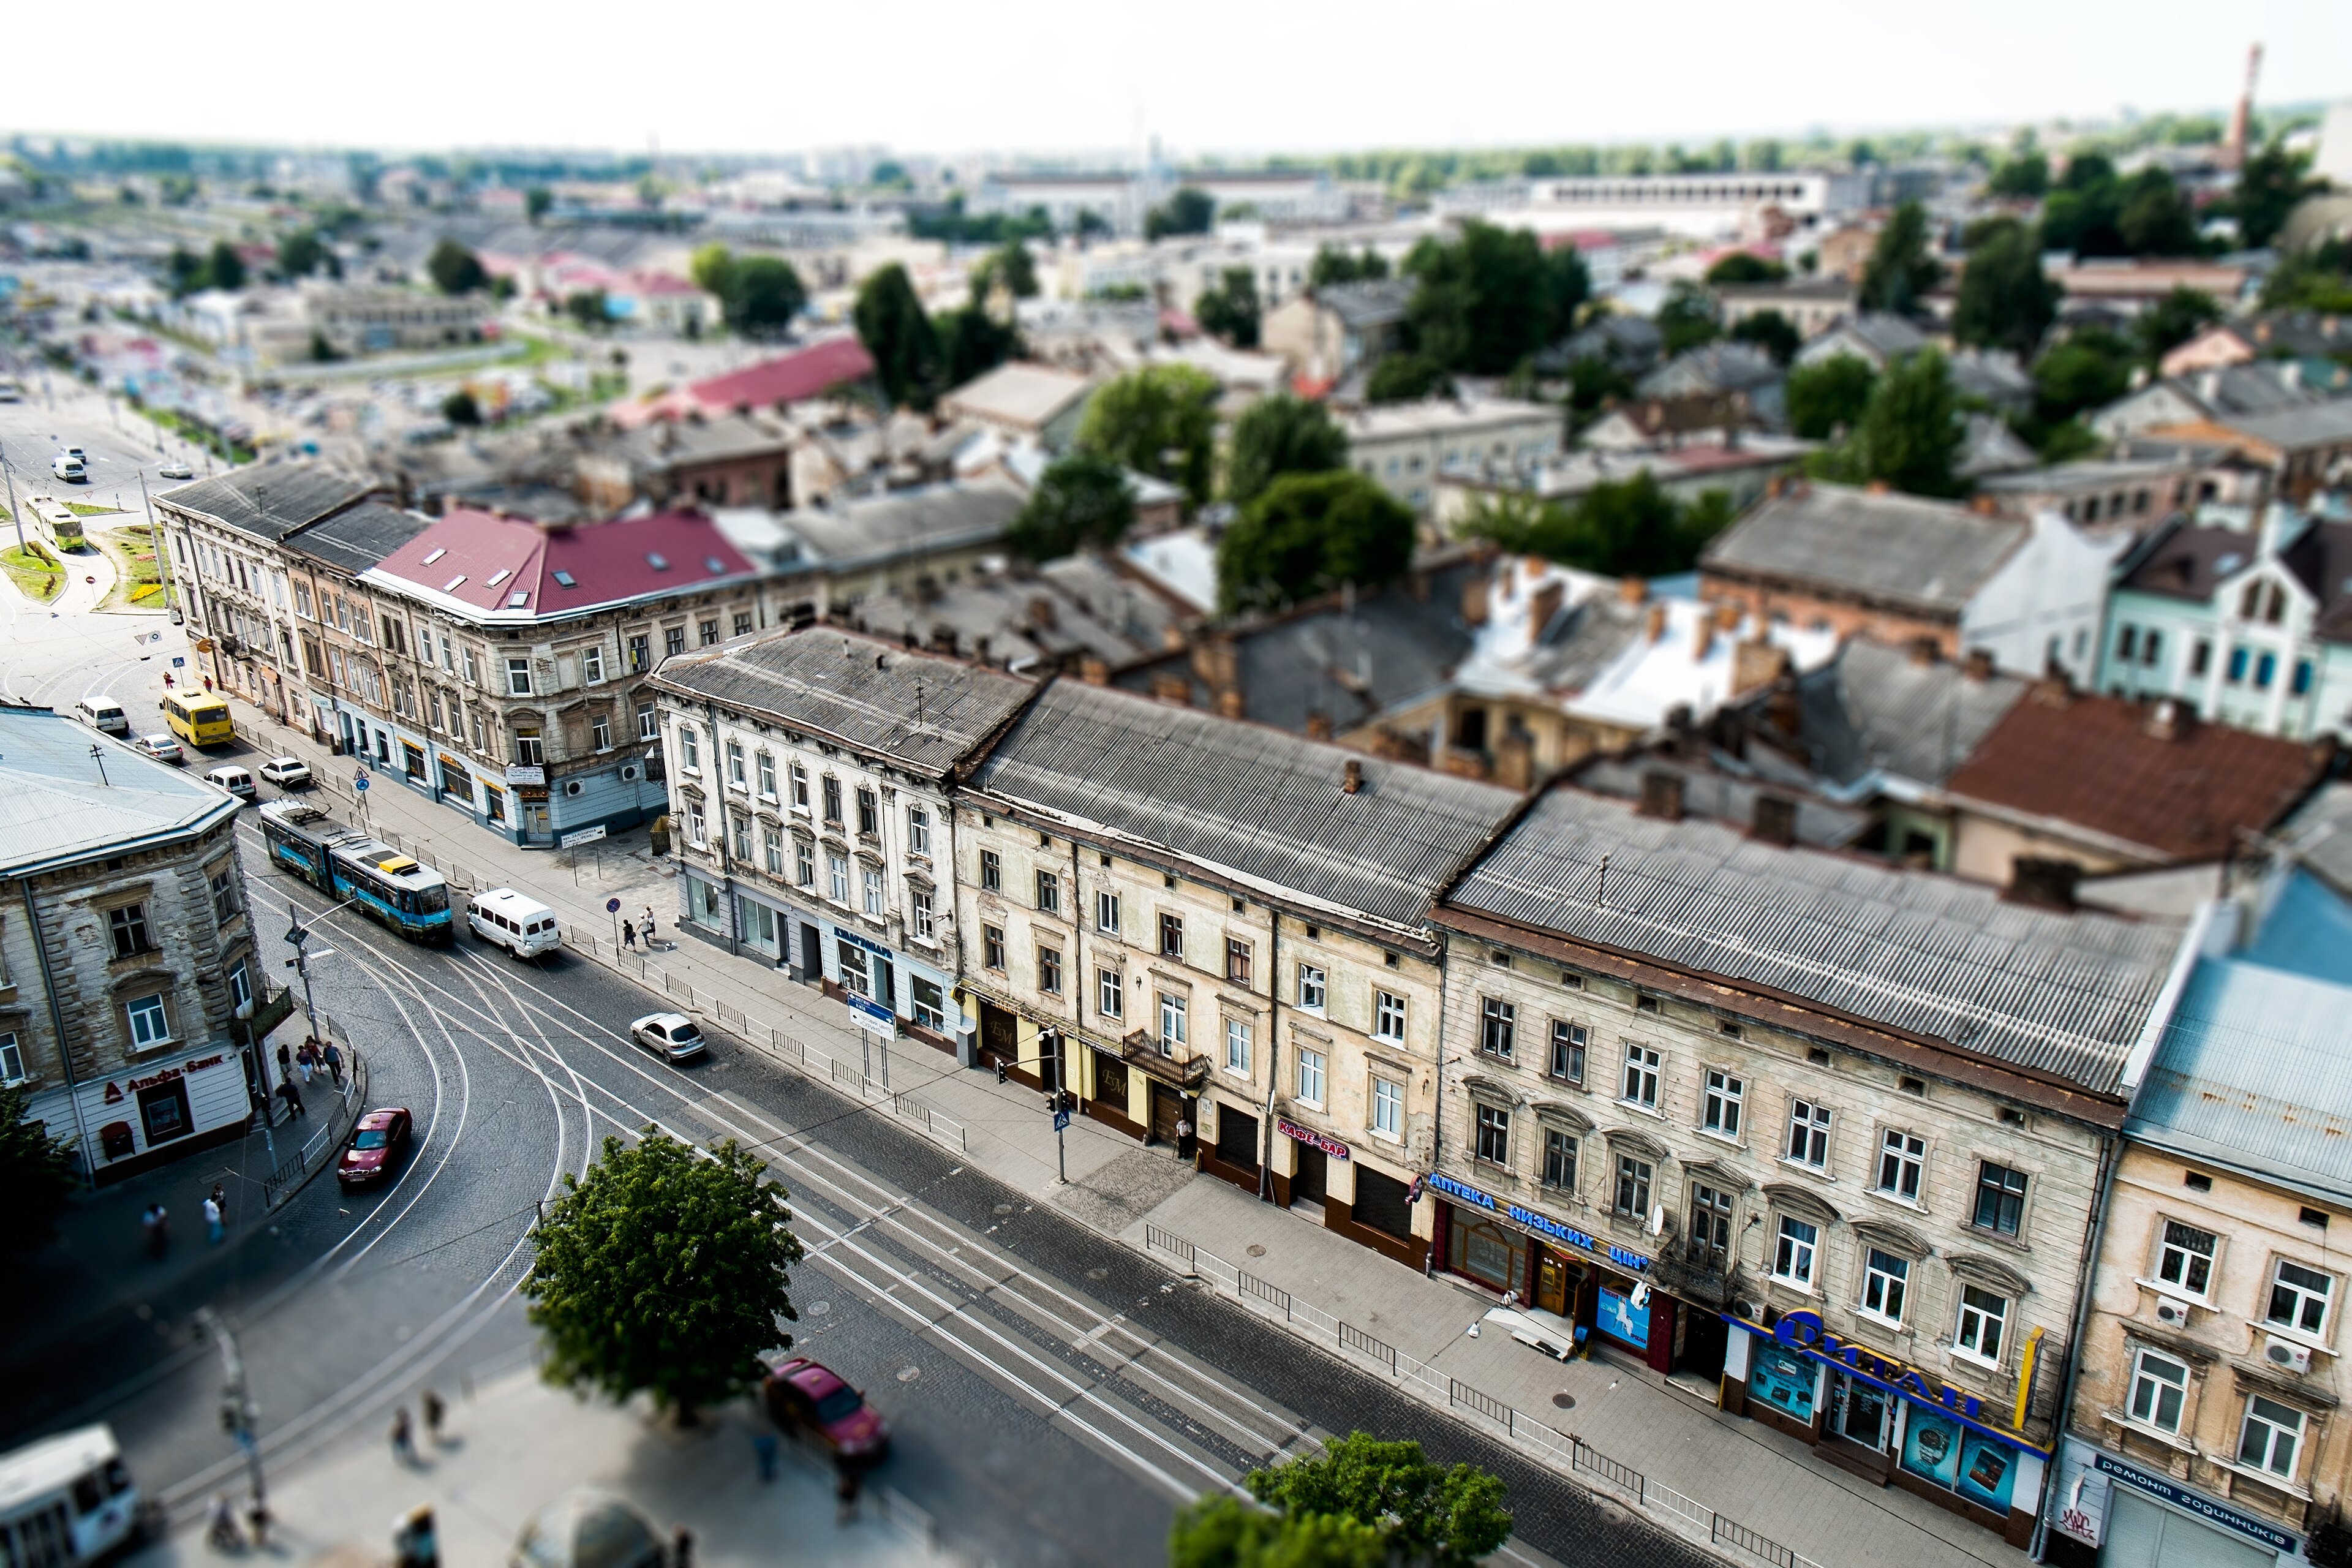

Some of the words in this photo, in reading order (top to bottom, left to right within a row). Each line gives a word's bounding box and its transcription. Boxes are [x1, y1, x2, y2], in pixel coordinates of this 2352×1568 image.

[1278, 1121, 1346, 1157] КАФЕ-БАР
[1429, 1172, 1494, 1210] АПТЕКА
[1509, 1205, 1594, 1251] НИЗЬКИХ
[2103, 1460, 2171, 1496] ремонт
[2181, 1494, 2286, 1545] годинників
